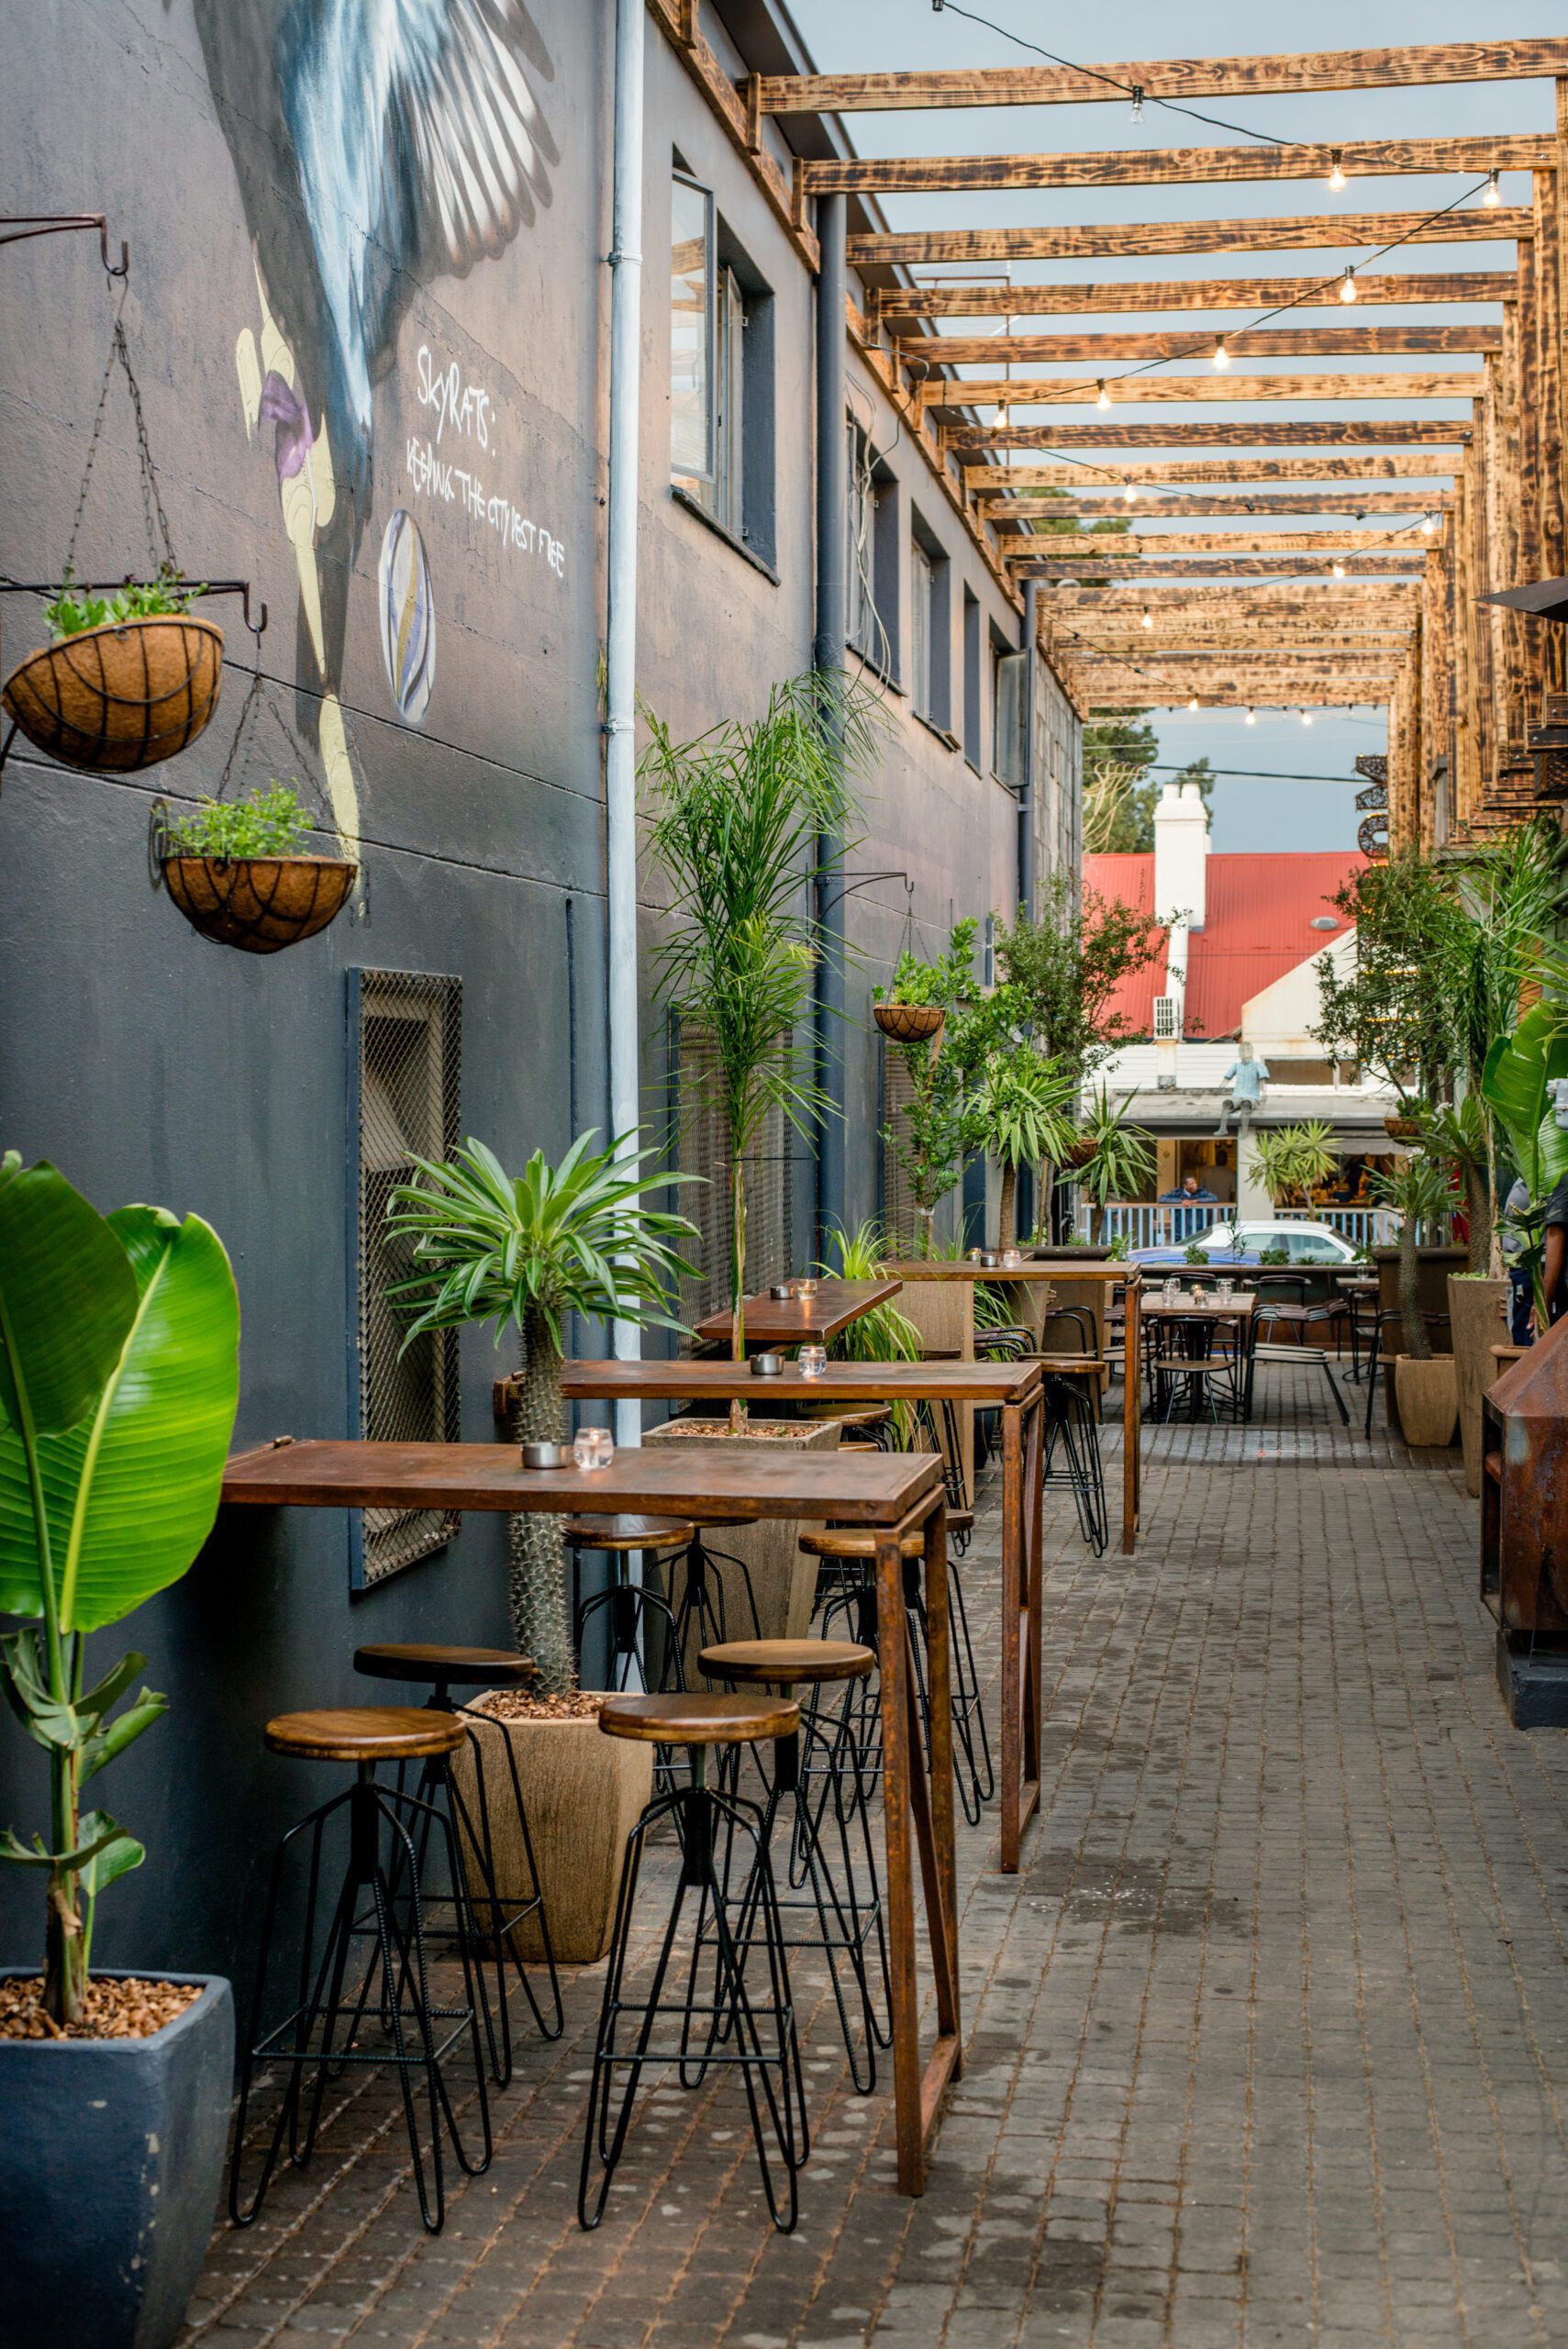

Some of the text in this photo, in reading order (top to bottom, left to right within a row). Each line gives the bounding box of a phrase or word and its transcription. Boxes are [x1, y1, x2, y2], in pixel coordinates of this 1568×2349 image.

[454, 469, 485, 520] THE
[487, 495, 510, 548] CITY
[511, 505, 537, 554] PEST
[539, 528, 565, 578] FREE
